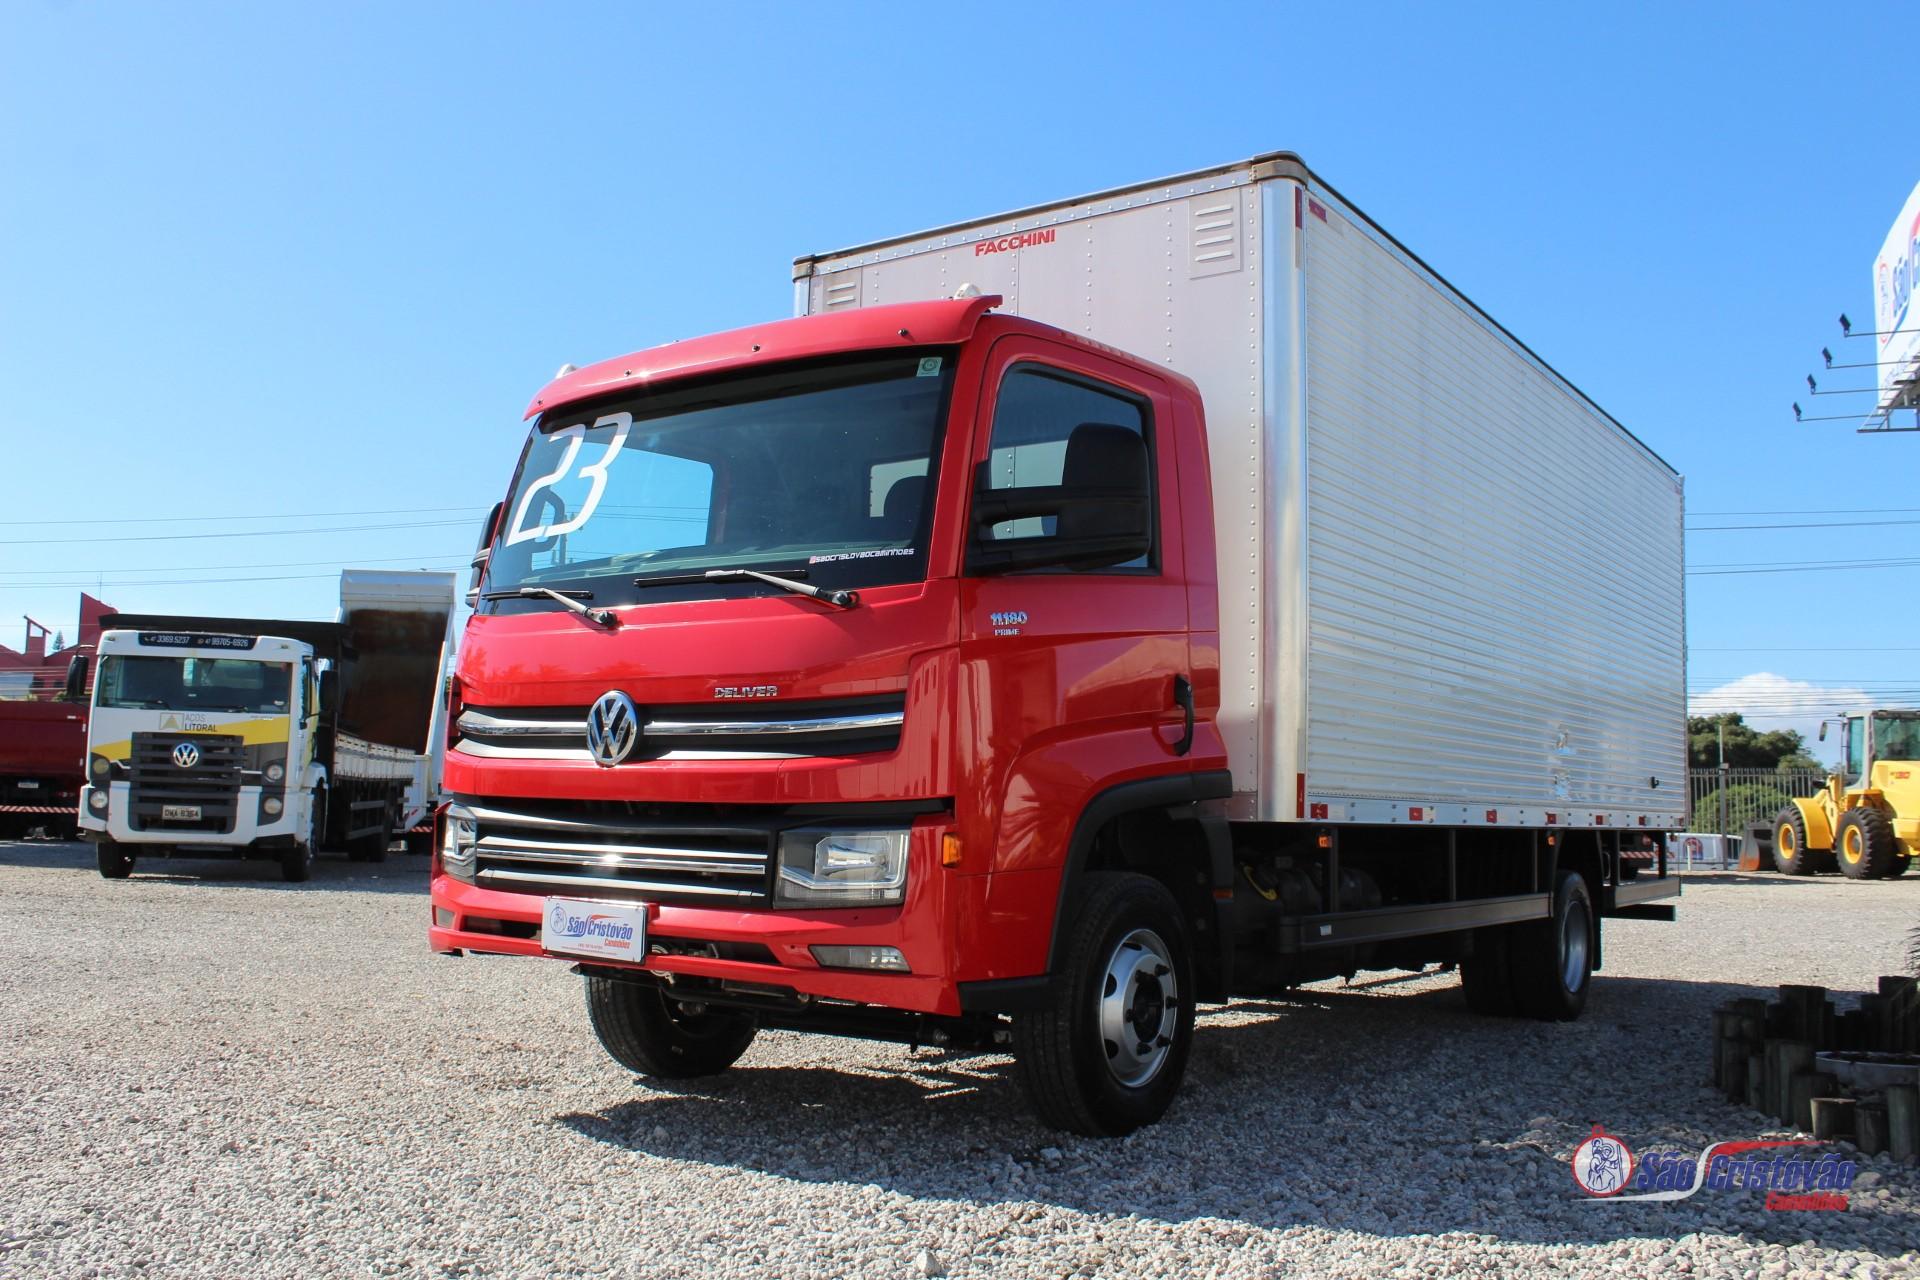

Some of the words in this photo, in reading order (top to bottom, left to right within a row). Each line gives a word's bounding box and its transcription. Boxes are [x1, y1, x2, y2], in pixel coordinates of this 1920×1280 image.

[975, 229, 1056, 256] FACCHINI
[506, 412, 632, 547] 23
[994, 628, 1021, 636] PRIME
[714, 685, 778, 699] DELIVER
[184, 723, 218, 733] LITORAL
[567, 916, 585, 934] São
[587, 919, 633, 940] Cristóvão
